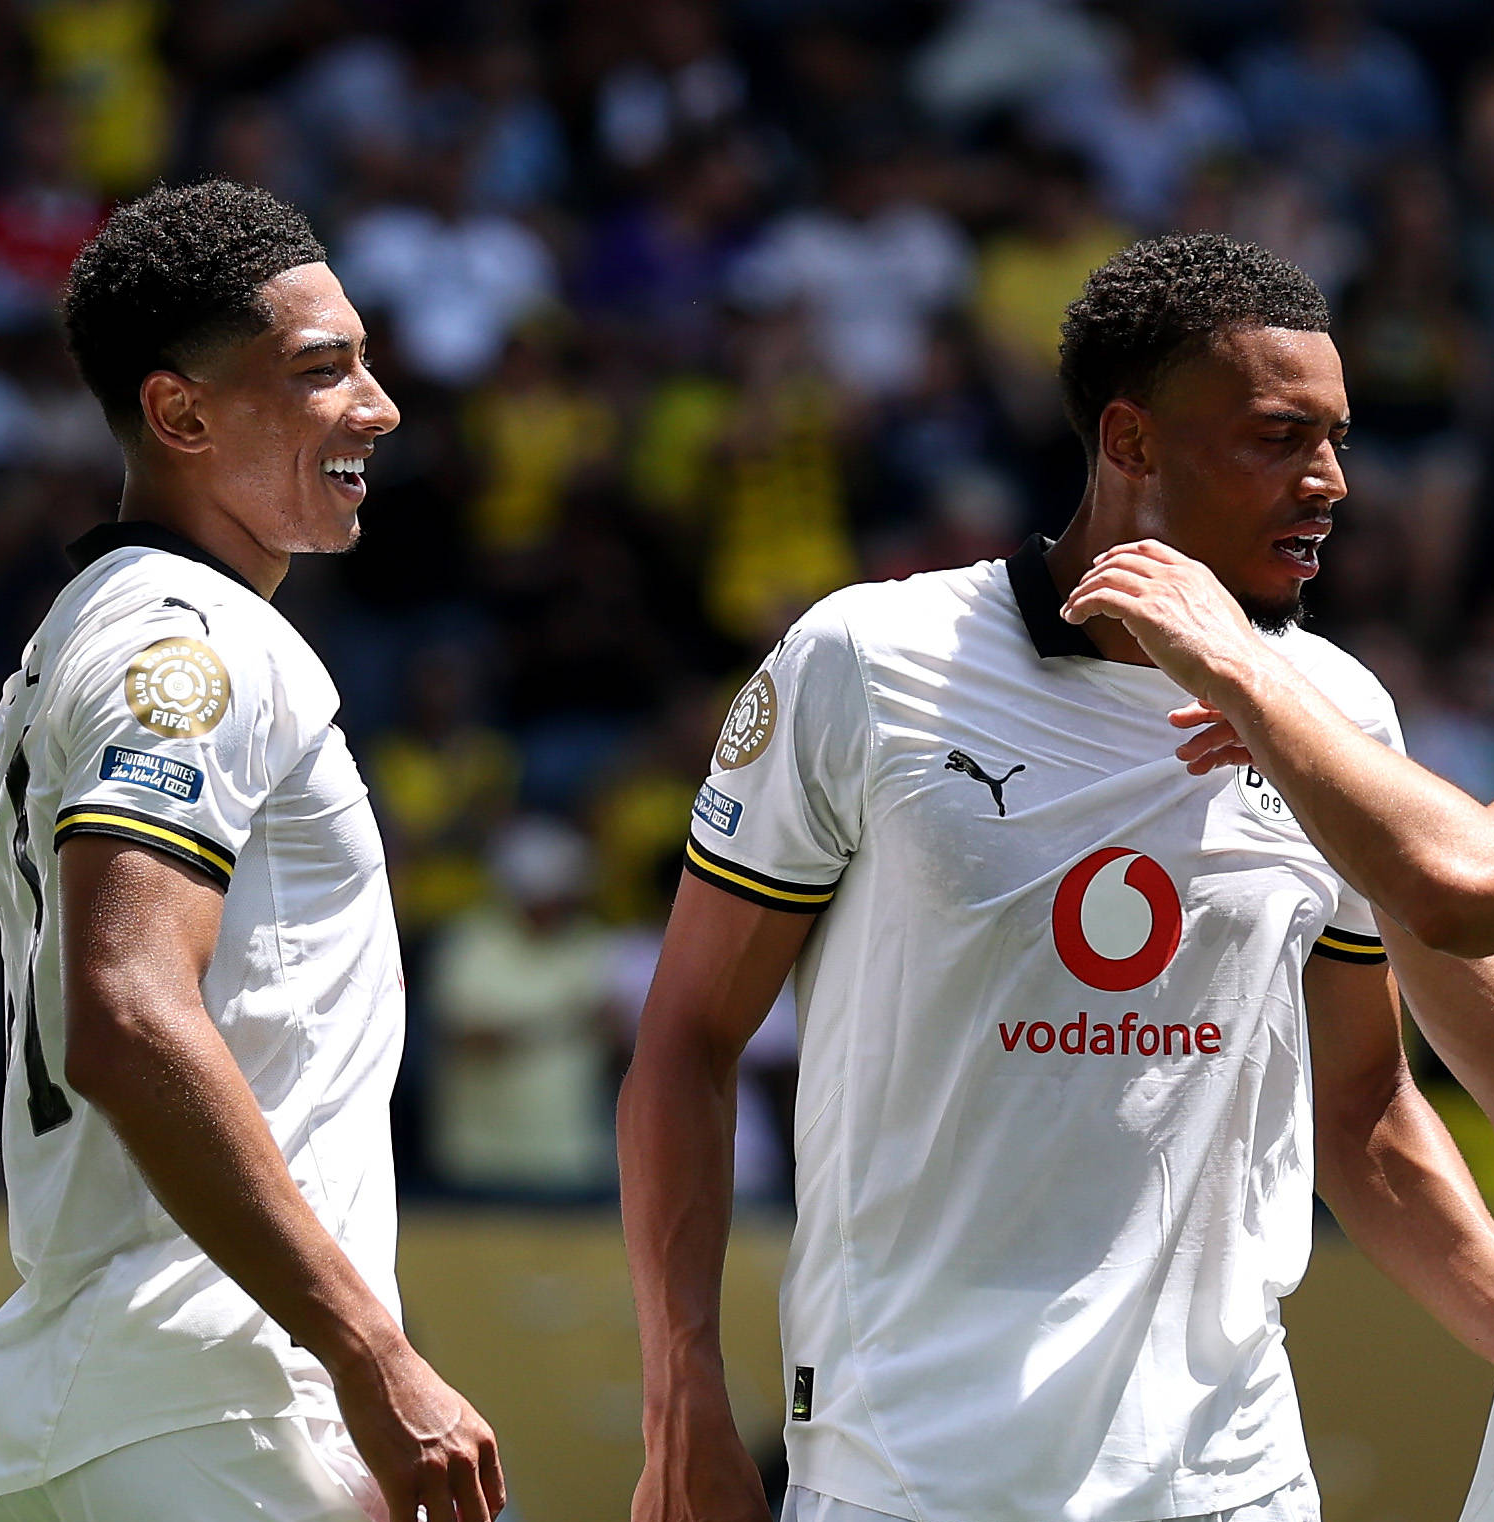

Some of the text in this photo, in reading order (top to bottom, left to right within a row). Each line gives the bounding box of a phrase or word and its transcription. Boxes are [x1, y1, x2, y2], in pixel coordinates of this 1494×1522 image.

[135, 646, 222, 723] CLUB WORLD CUP 25 USA
[150, 708, 191, 731] FIFA
[742, 682, 770, 752] CUP 25 USA
[720, 743, 739, 764] FIFA
[110, 764, 167, 788] the World
[115, 750, 196, 783] FOOTBALL UNITES
[168, 780, 188, 796] FIFA
[1261, 793, 1282, 813] 09
[713, 811, 727, 827] FIFA
[998, 1011, 1223, 1057] vodafone
